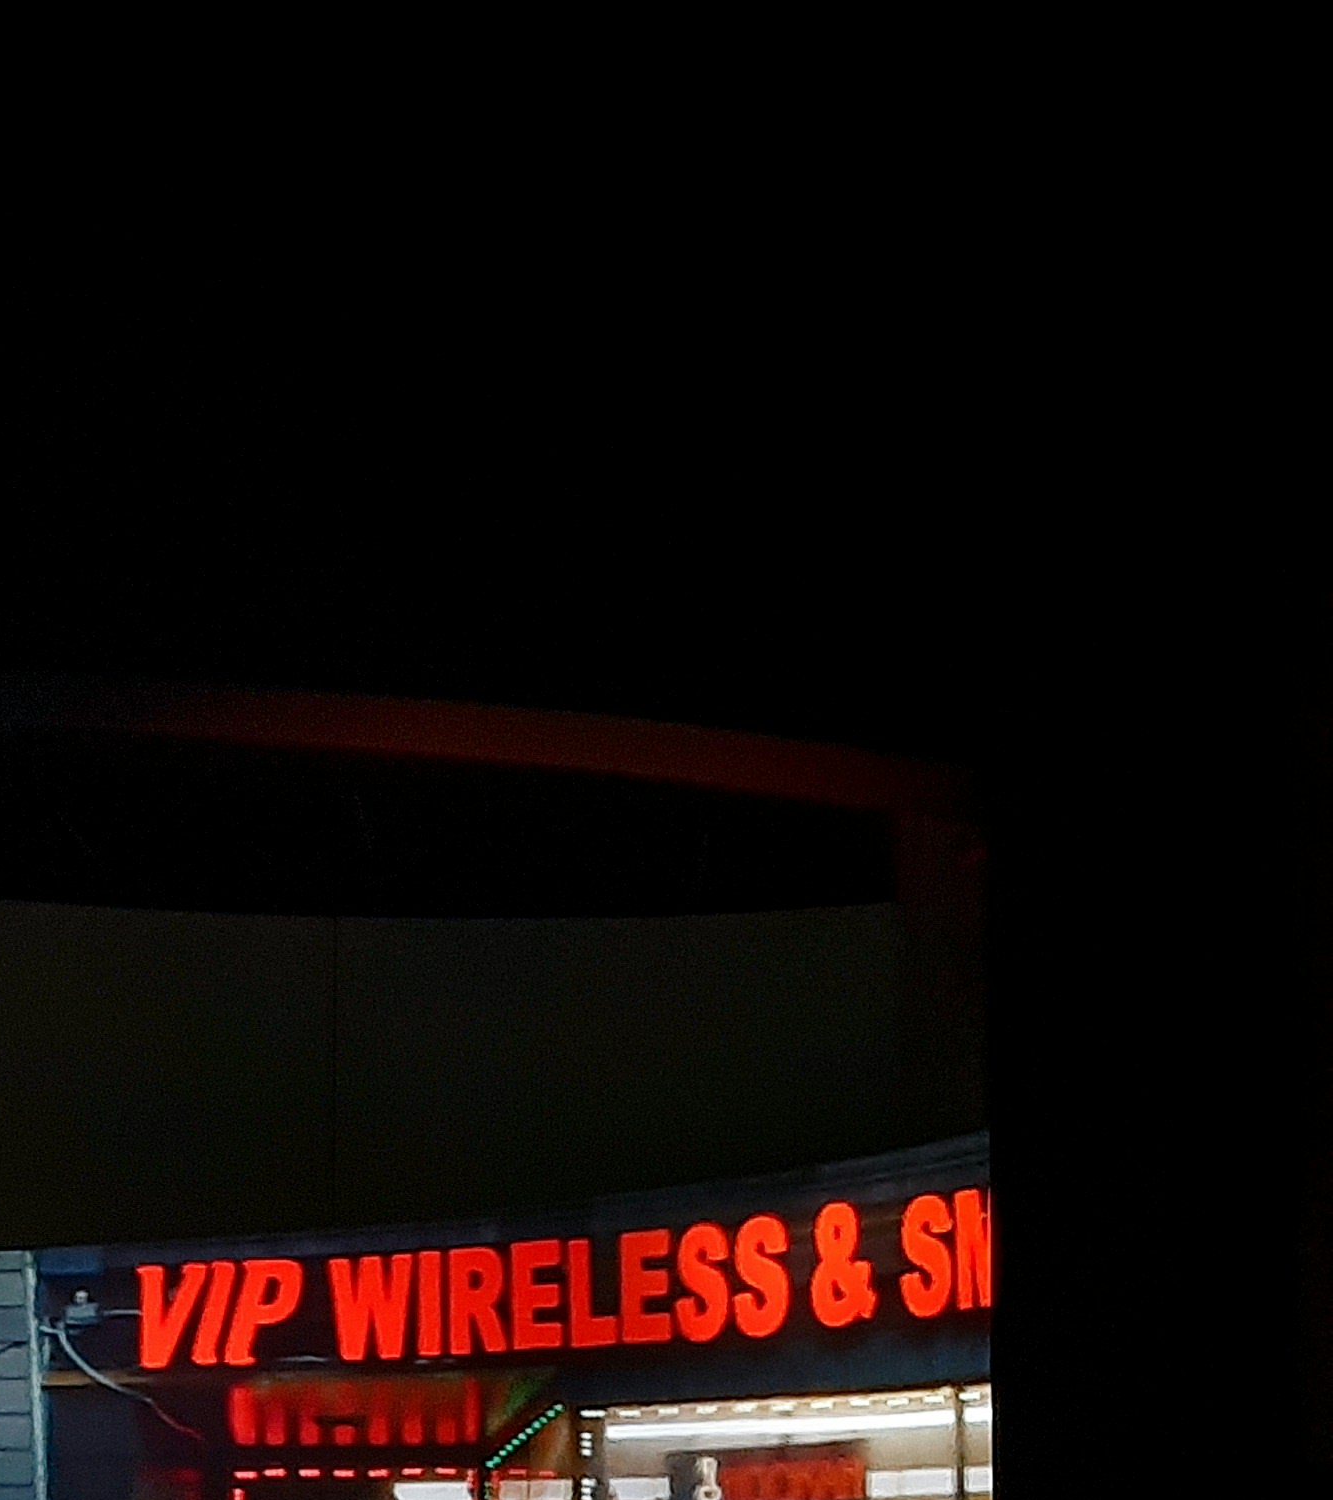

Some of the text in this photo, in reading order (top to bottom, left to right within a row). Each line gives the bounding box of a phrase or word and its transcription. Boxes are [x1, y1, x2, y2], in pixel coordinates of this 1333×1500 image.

[136, 1257, 304, 1370] VIP
[328, 1214, 789, 1364] WIRELESS
[811, 1202, 876, 1328] &
